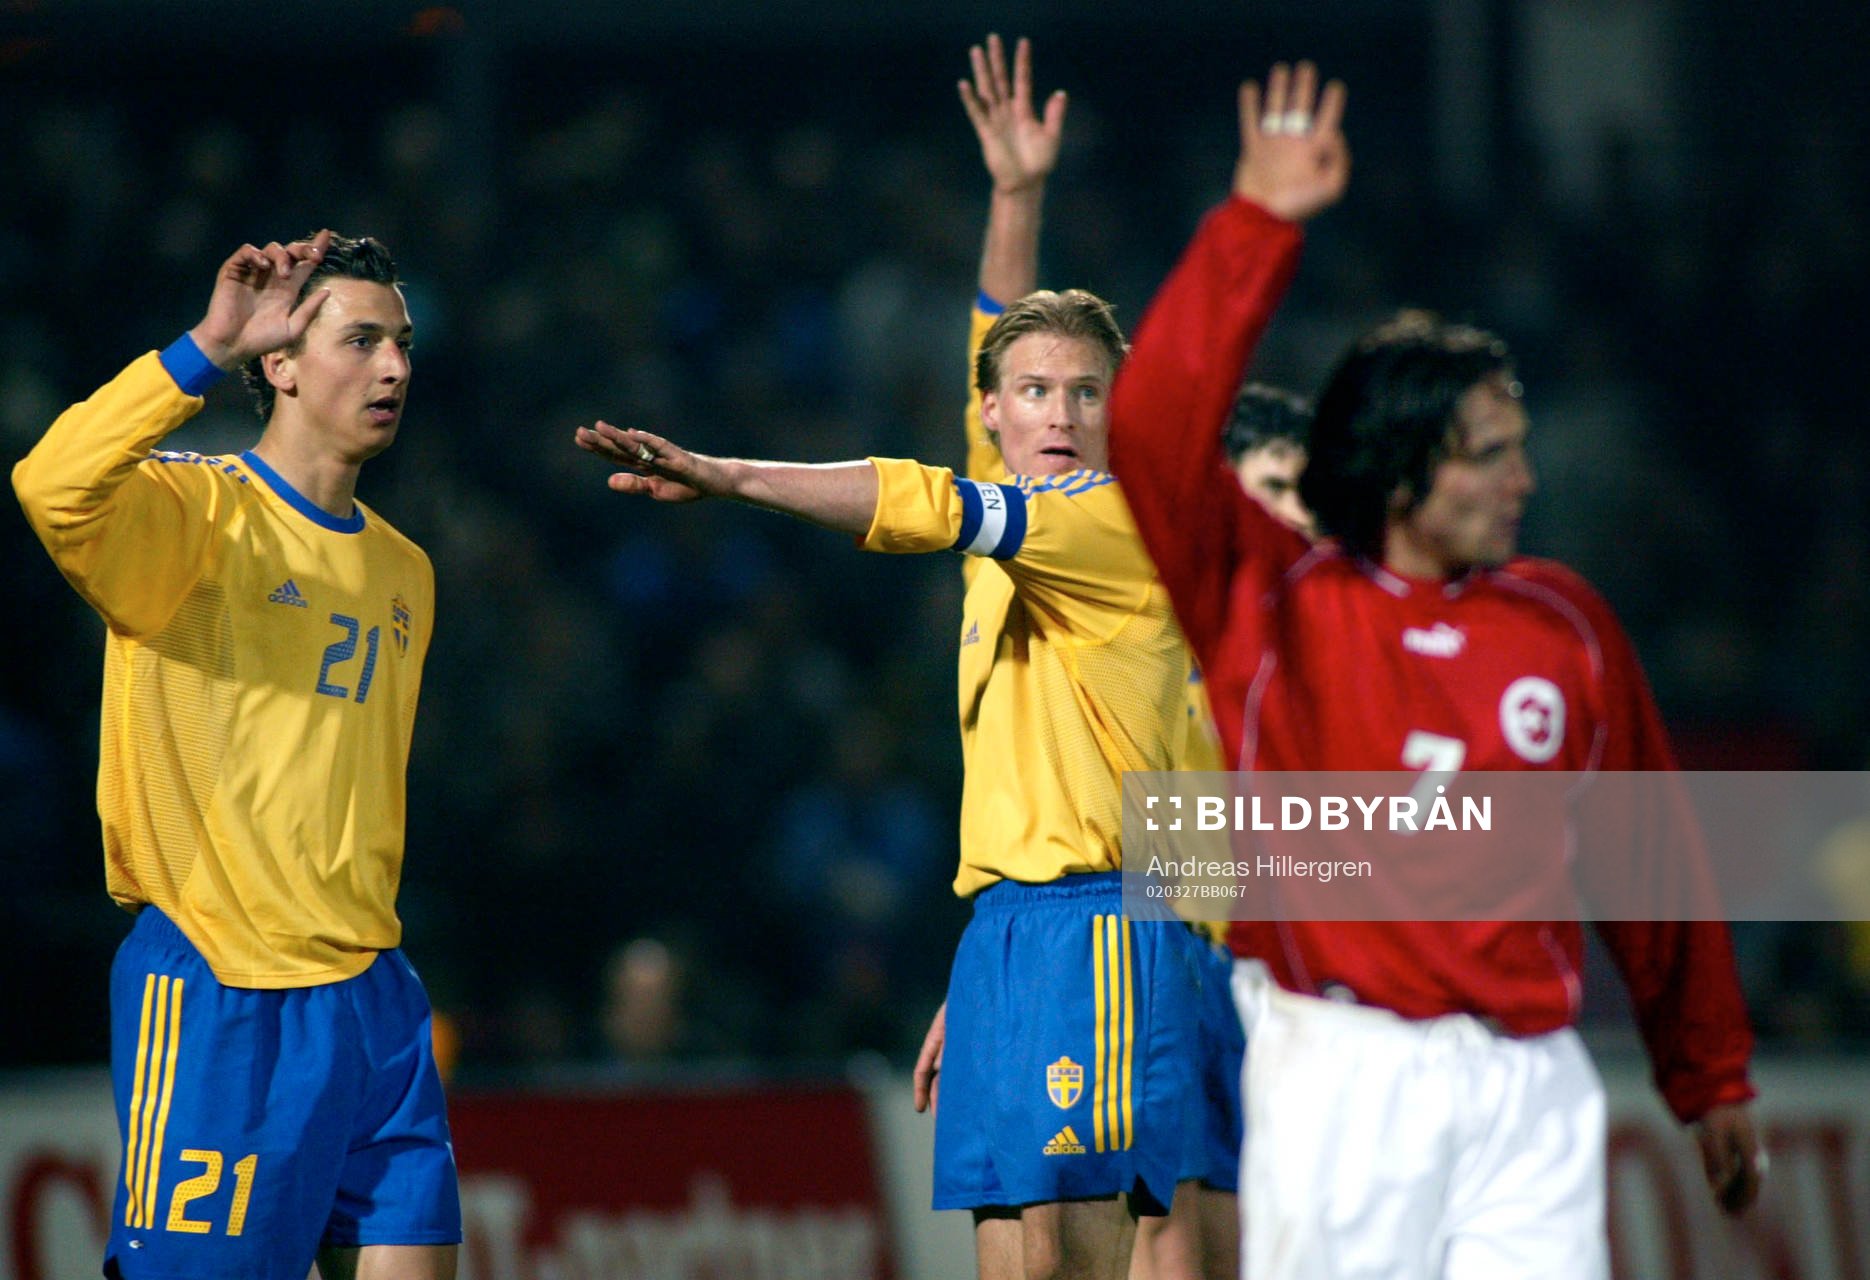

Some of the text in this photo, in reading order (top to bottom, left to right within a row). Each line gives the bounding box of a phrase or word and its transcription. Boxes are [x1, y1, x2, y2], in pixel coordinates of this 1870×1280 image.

[315, 613, 380, 704] 21
[1397, 729, 1467, 836] 7
[166, 1149, 258, 1237] 21
